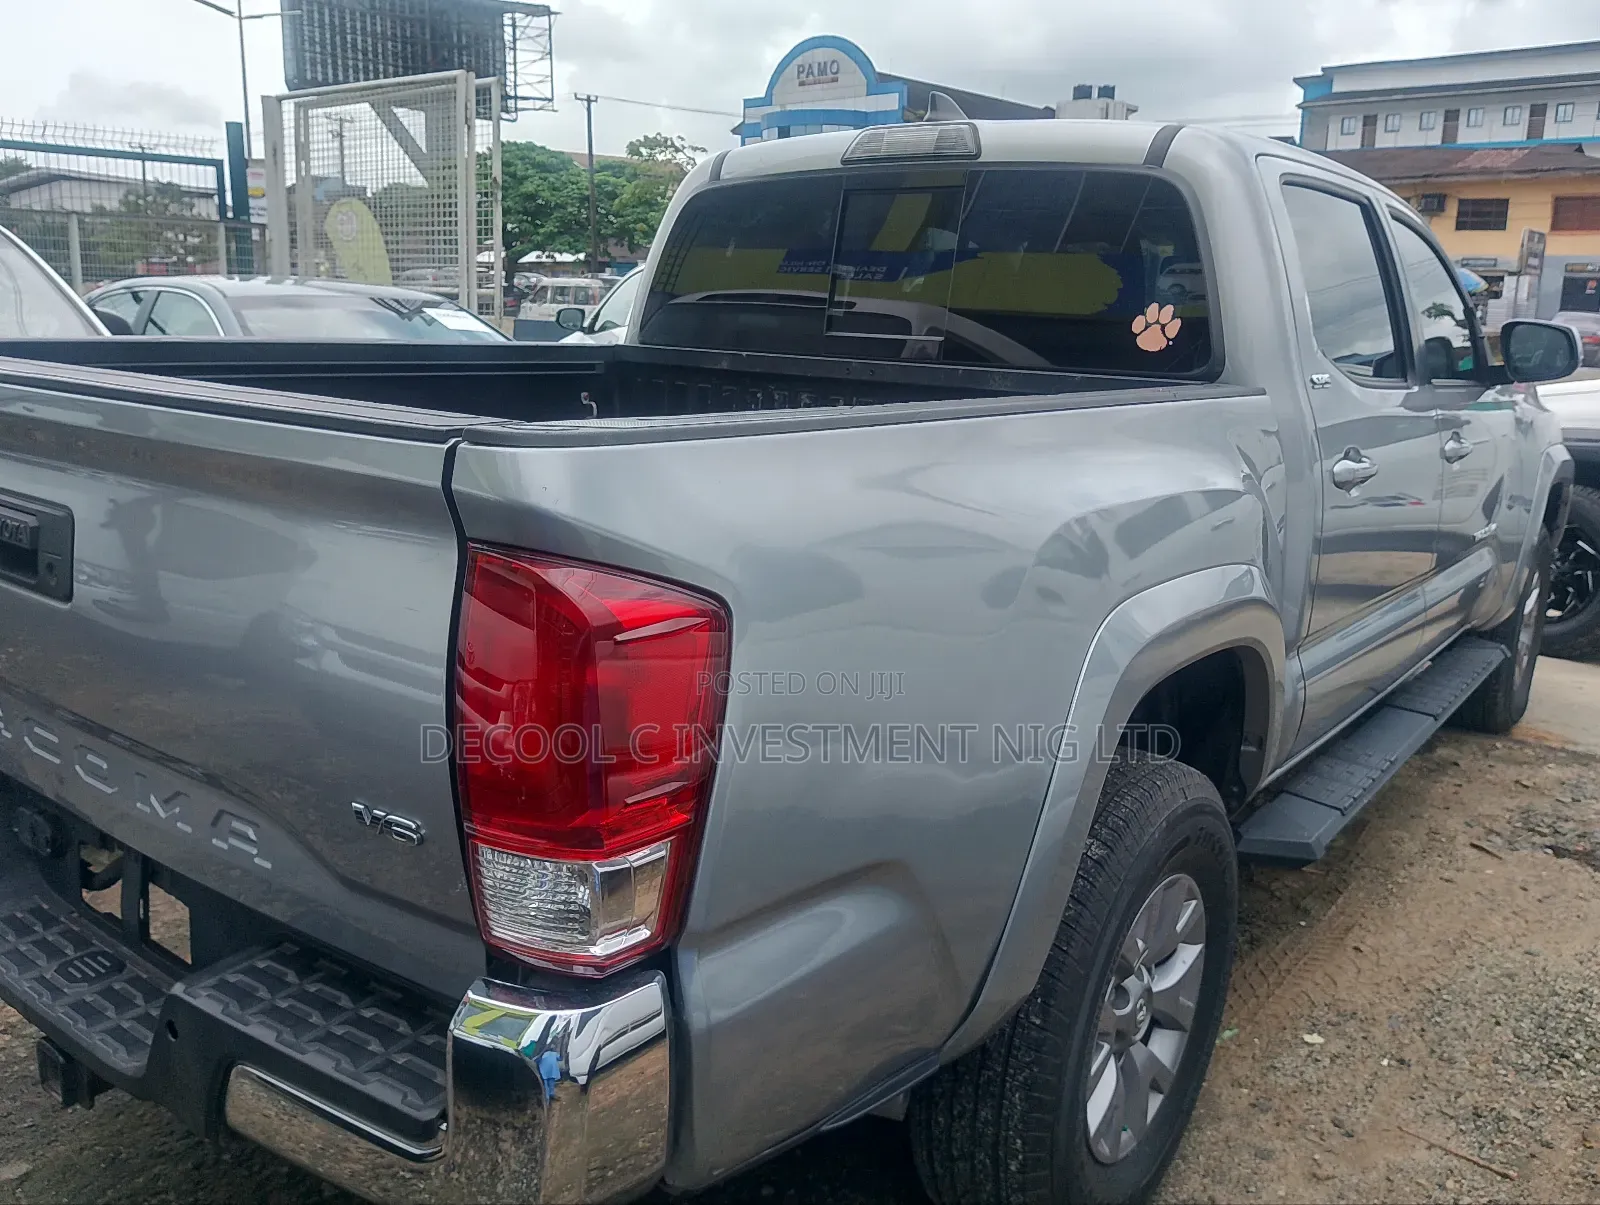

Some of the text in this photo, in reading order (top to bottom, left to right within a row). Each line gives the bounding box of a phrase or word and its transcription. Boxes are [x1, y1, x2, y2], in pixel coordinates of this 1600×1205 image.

[797, 59, 840, 79] PAMO
[0, 518, 30, 546] OTA
[351, 801, 425, 847] V6
